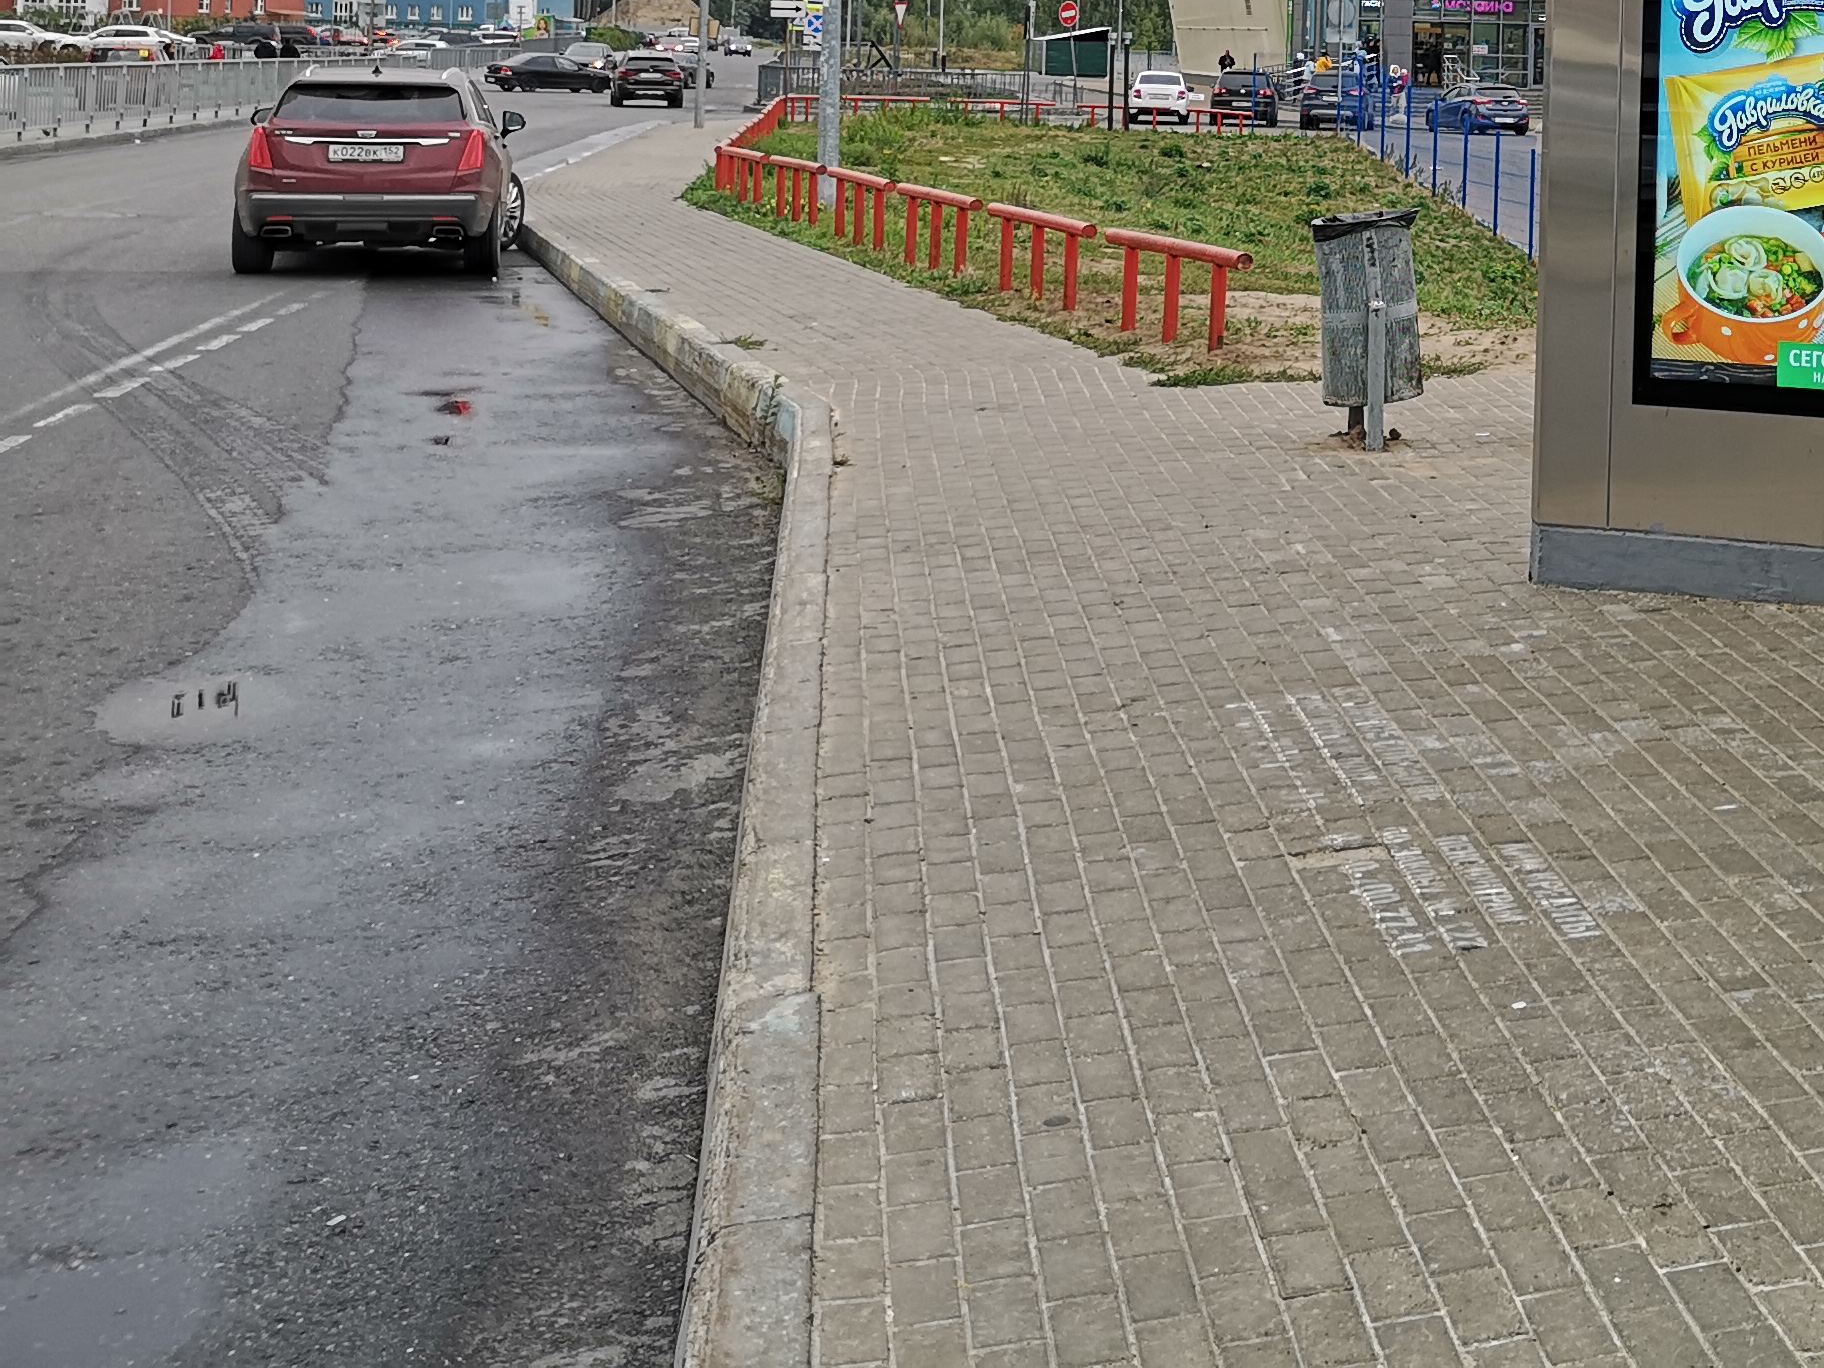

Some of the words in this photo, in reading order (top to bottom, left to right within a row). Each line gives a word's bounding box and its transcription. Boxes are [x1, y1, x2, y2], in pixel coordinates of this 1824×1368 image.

[1747, 134, 1818, 158] ПЕЛЬМЕНИ
[1750, 162, 1758, 172] С
[1762, 151, 1821, 170] КУРИЦЕЙ
